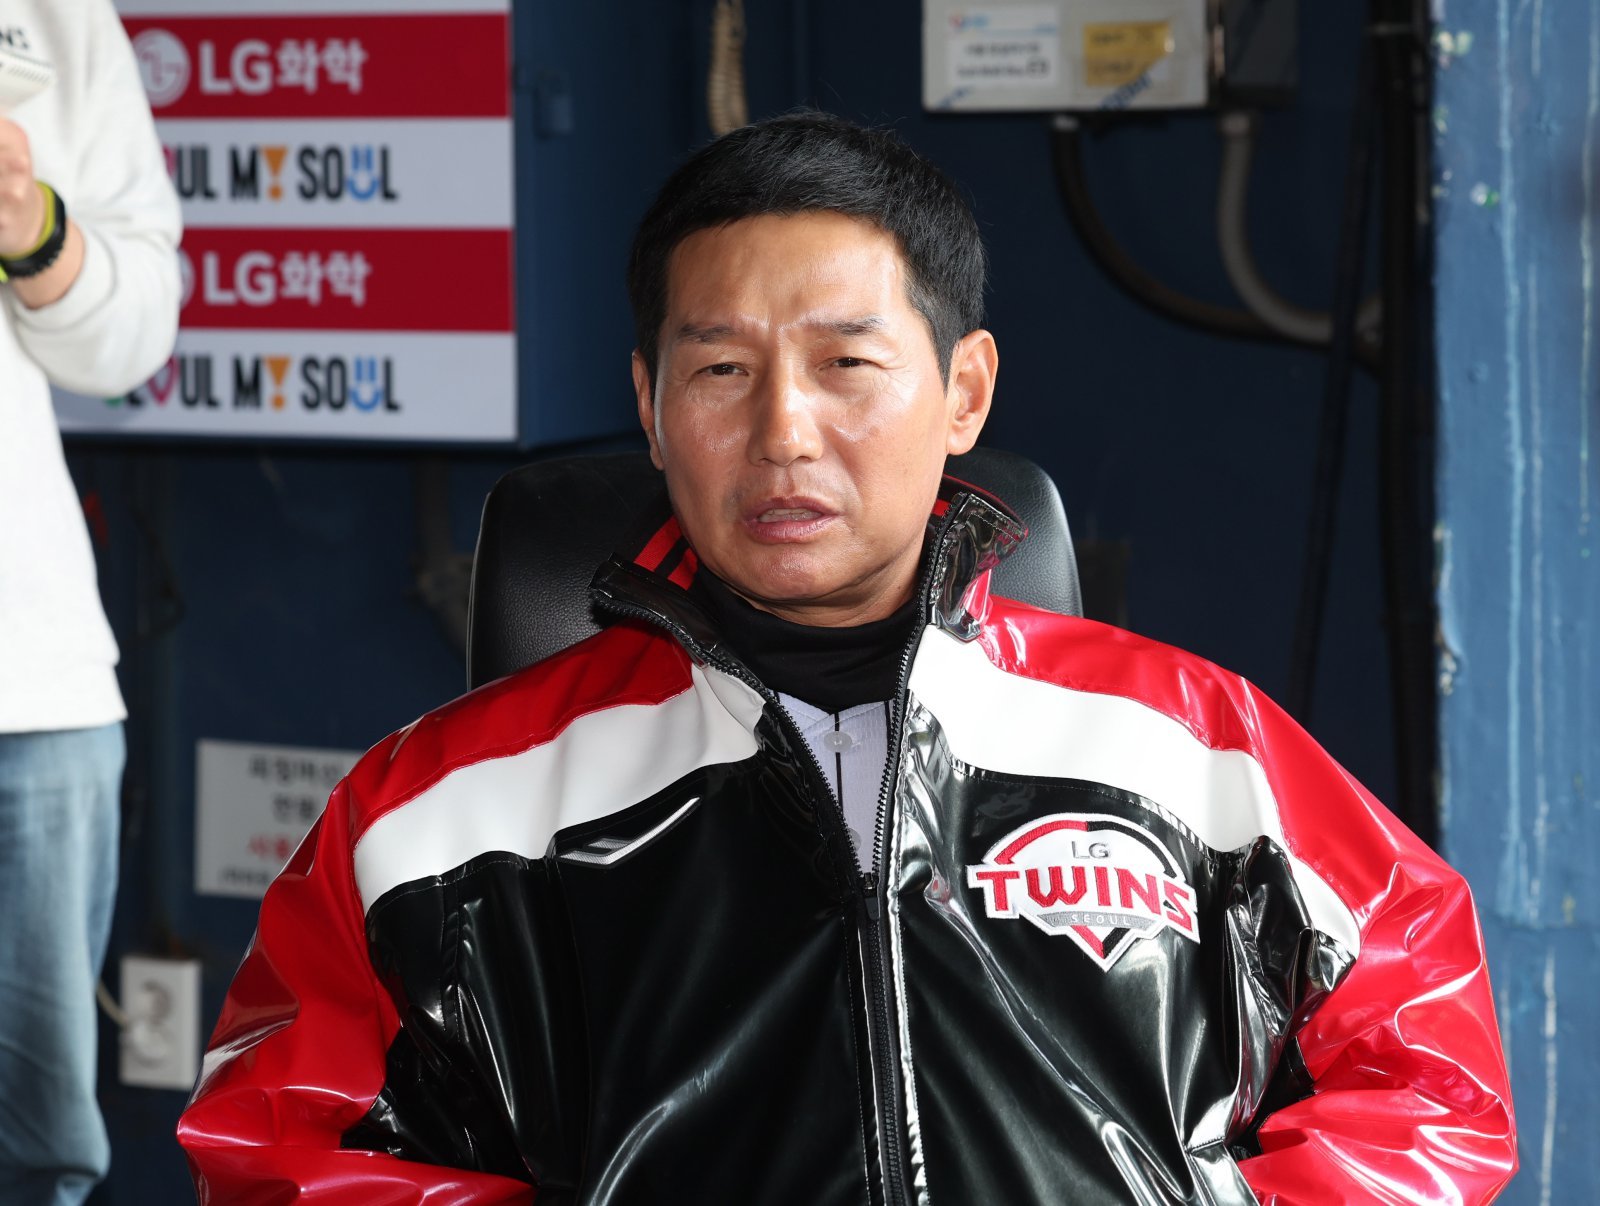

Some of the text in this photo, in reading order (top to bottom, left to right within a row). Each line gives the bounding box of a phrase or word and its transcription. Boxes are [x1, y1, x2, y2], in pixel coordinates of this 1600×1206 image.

[198, 38, 368, 95] LG화학
[297, 144, 399, 202] SOUL
[203, 251, 372, 307] LG화학
[300, 355, 403, 412] SOUL
[1071, 840, 1111, 859] LG
[975, 866, 1193, 932] TWINS
[1070, 913, 1131, 926] SEOUL
